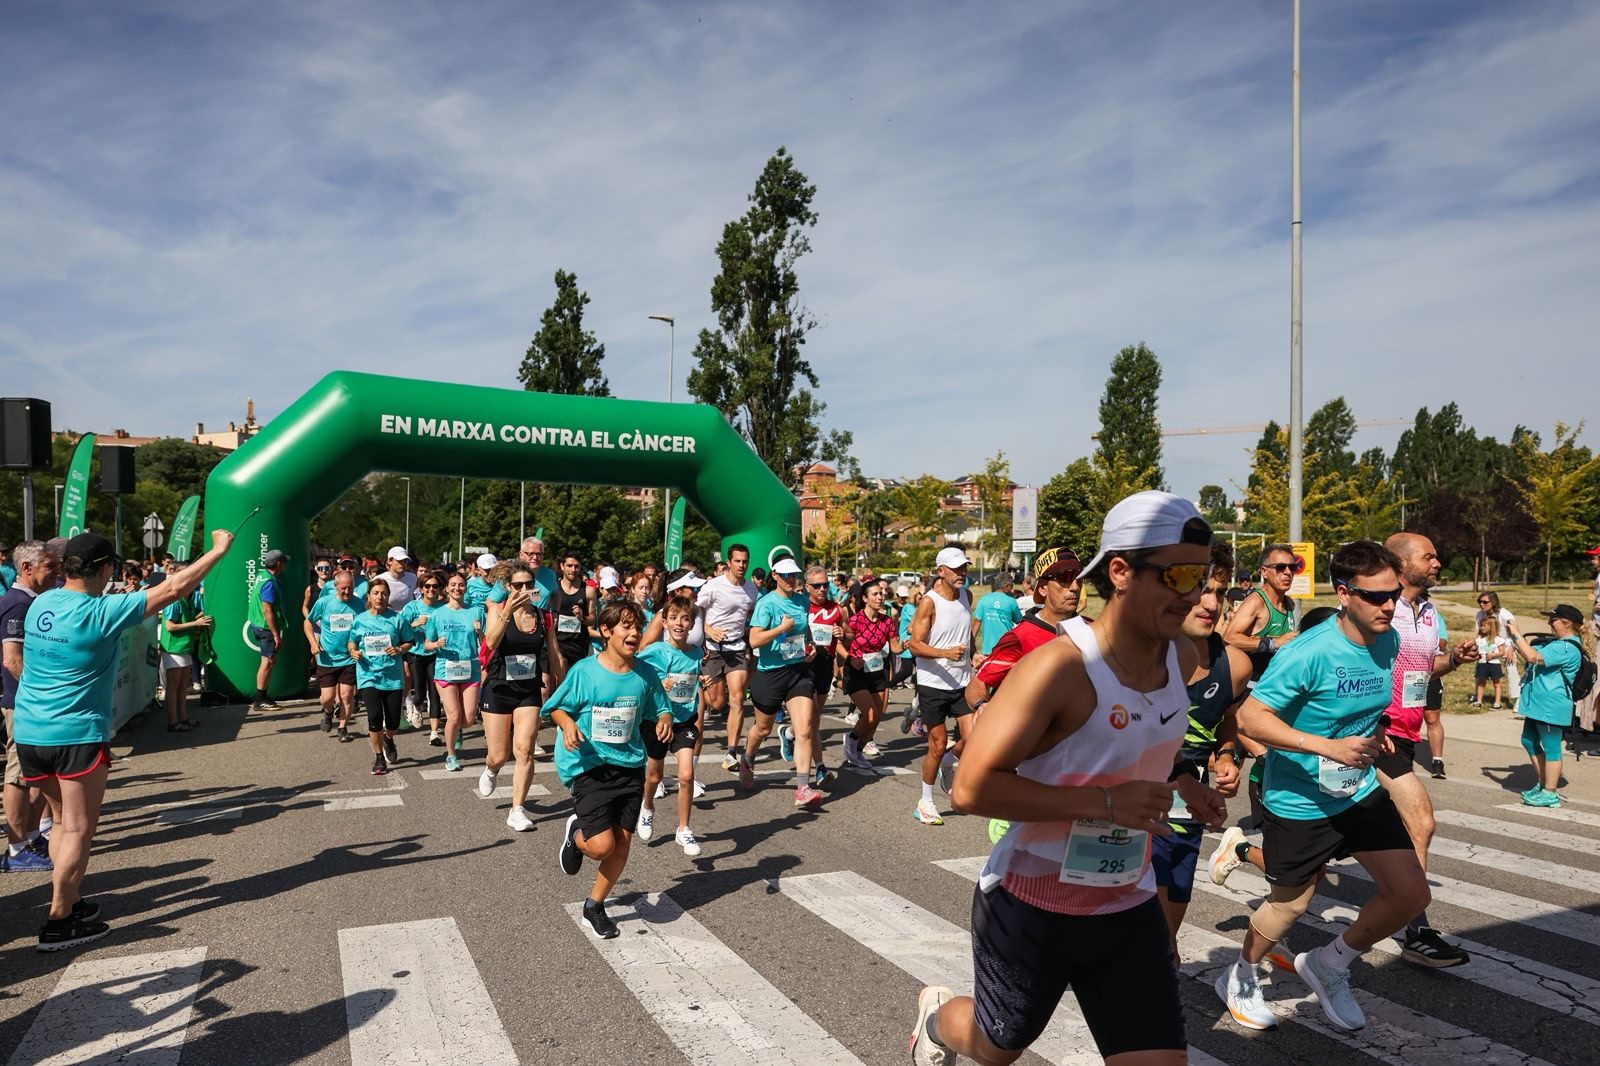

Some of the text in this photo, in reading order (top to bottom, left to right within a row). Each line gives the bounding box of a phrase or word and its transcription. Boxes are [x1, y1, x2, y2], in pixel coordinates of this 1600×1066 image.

[380, 414, 696, 453] EN MARXA CONTRA EL CÀNCER
[1336, 679, 1360, 694] KM
[1361, 676, 1384, 686] contra
[1131, 713, 1142, 722] NN
[1342, 778, 1357, 789] 296
[1098, 860, 1126, 874] 295
